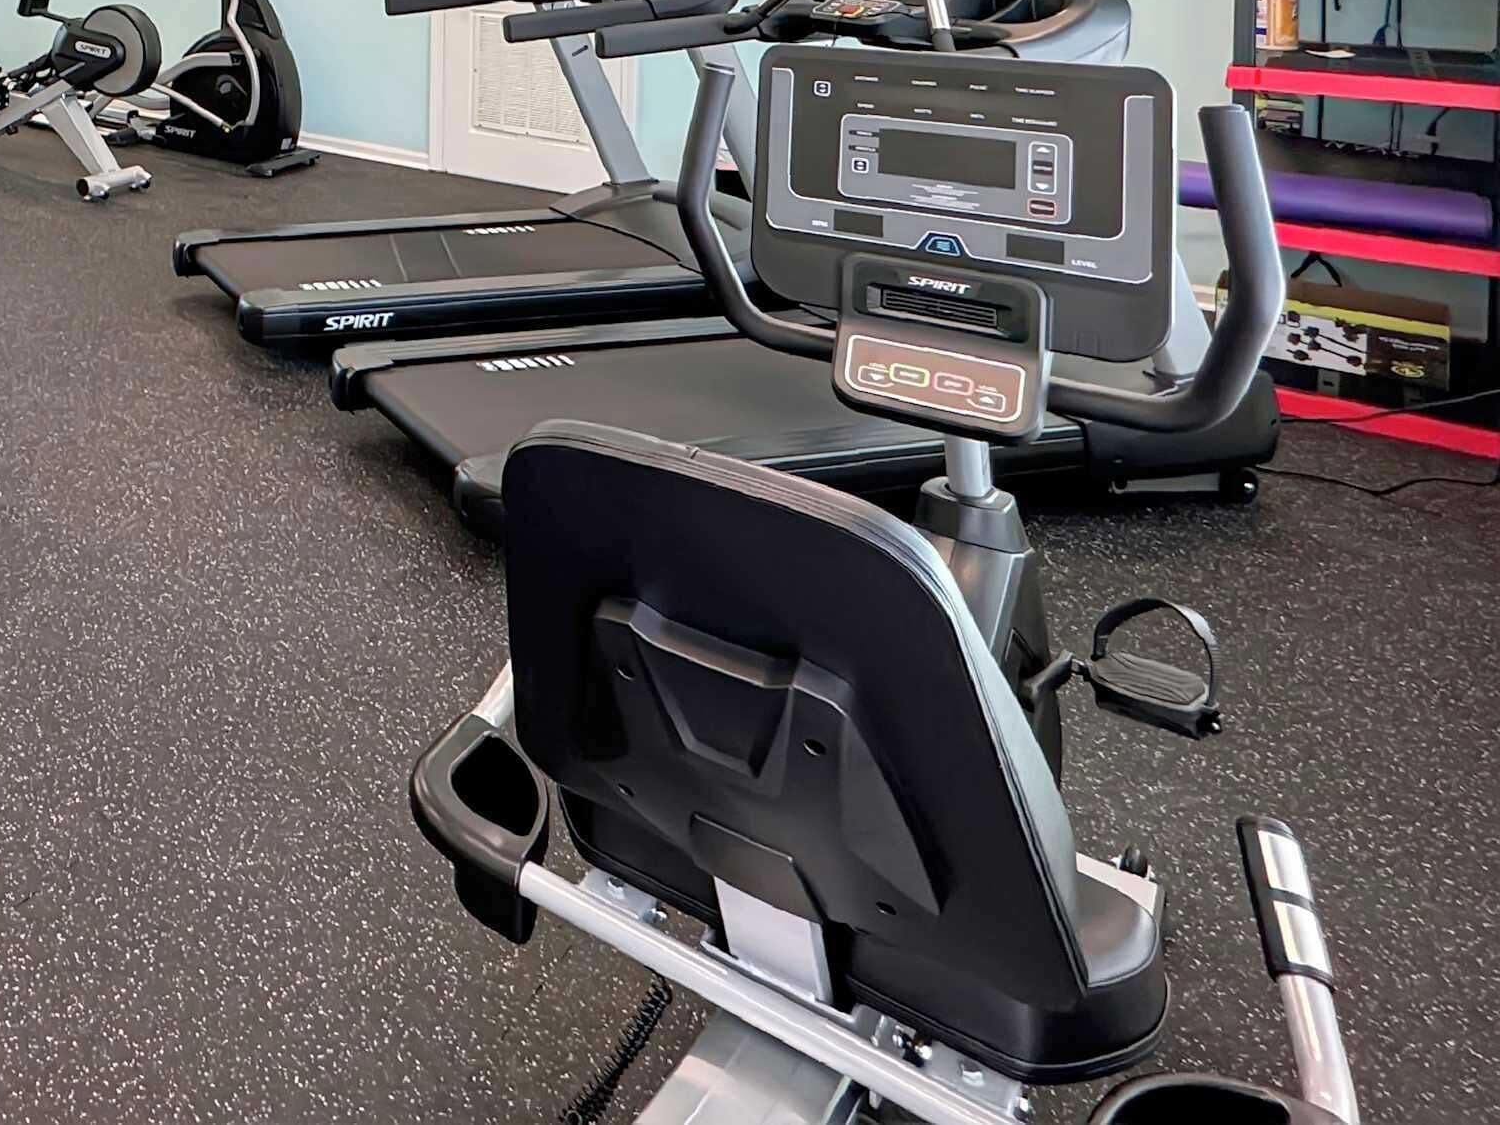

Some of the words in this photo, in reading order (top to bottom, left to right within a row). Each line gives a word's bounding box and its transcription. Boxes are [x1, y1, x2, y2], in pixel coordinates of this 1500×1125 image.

[164, 125, 196, 139] SPIRIT
[907, 276, 973, 295] SPIRIT
[323, 312, 395, 331] SPIRIT
